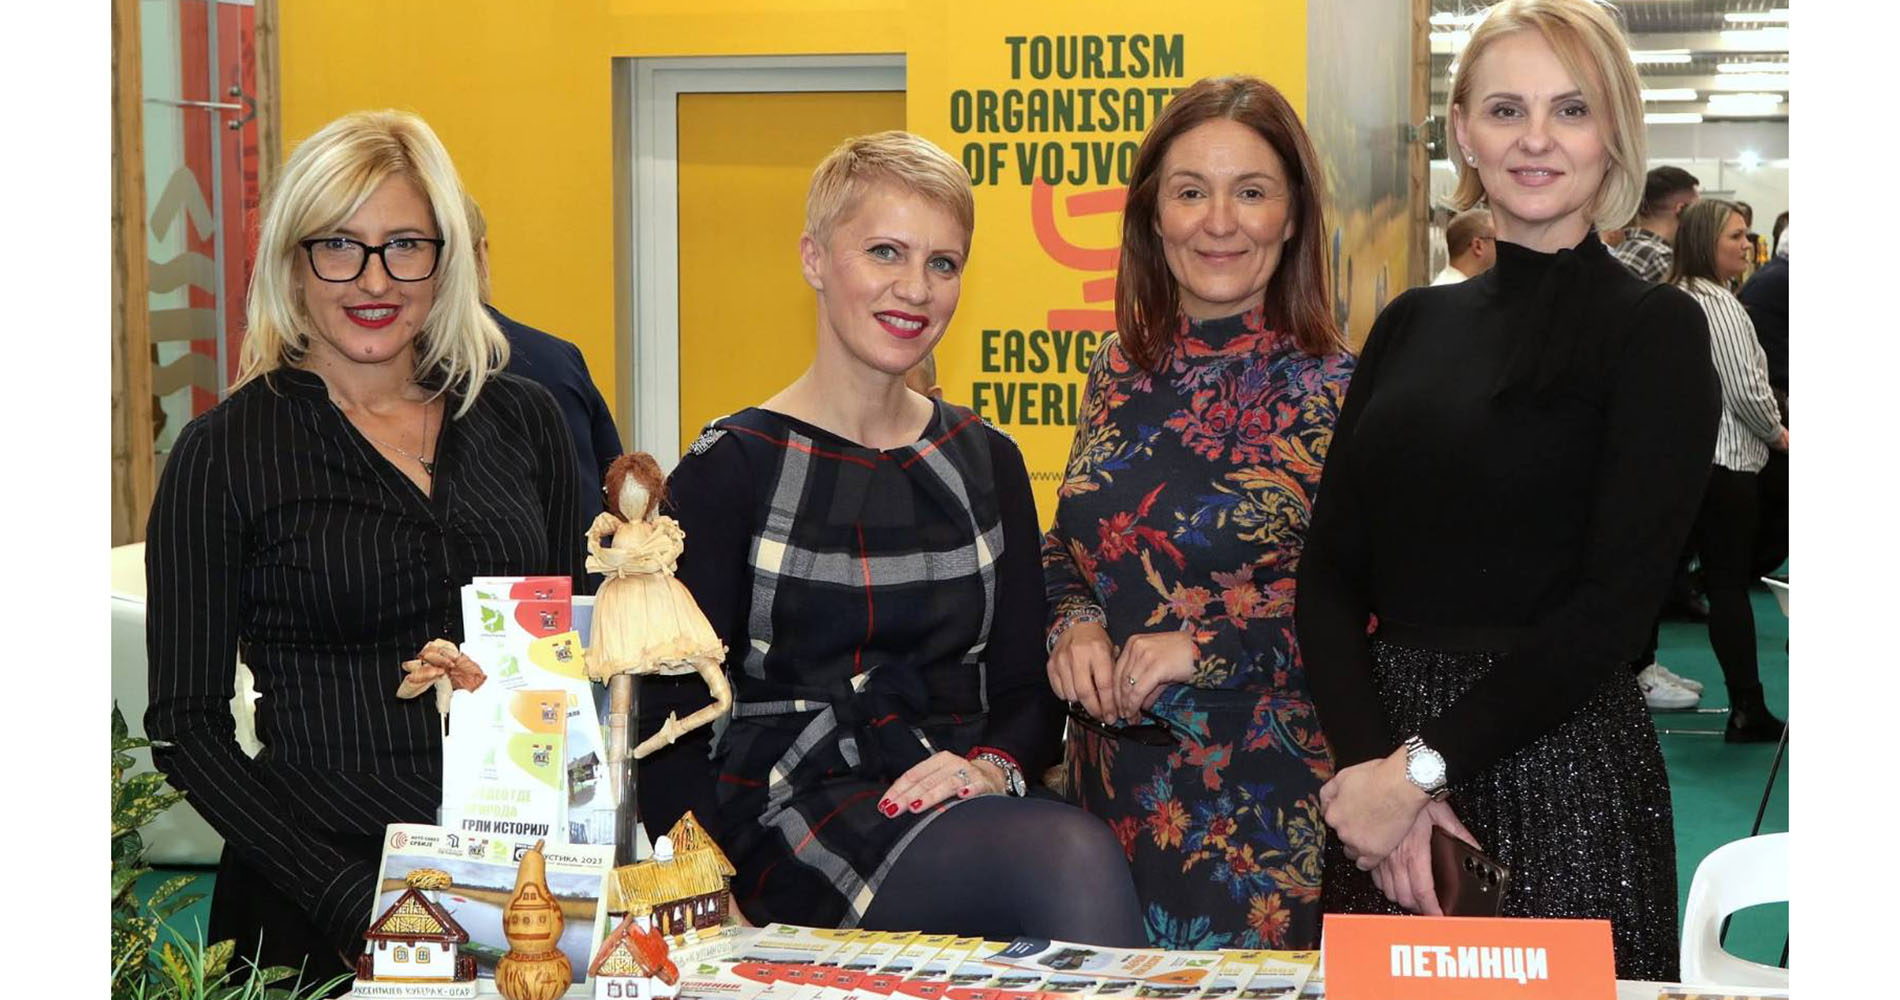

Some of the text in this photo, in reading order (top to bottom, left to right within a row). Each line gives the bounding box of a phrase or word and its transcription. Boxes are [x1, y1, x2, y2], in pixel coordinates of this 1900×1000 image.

[1005, 34, 1185, 80] TOURISM
[950, 87, 1187, 134] ORGANISAT
[962, 141, 1009, 187] OF
[981, 329, 1108, 374] EASYG
[462, 819, 549, 836] ГРЛИ ИСТОРИЈУ
[1390, 944, 1548, 984] ПЕЋИНЦИ
